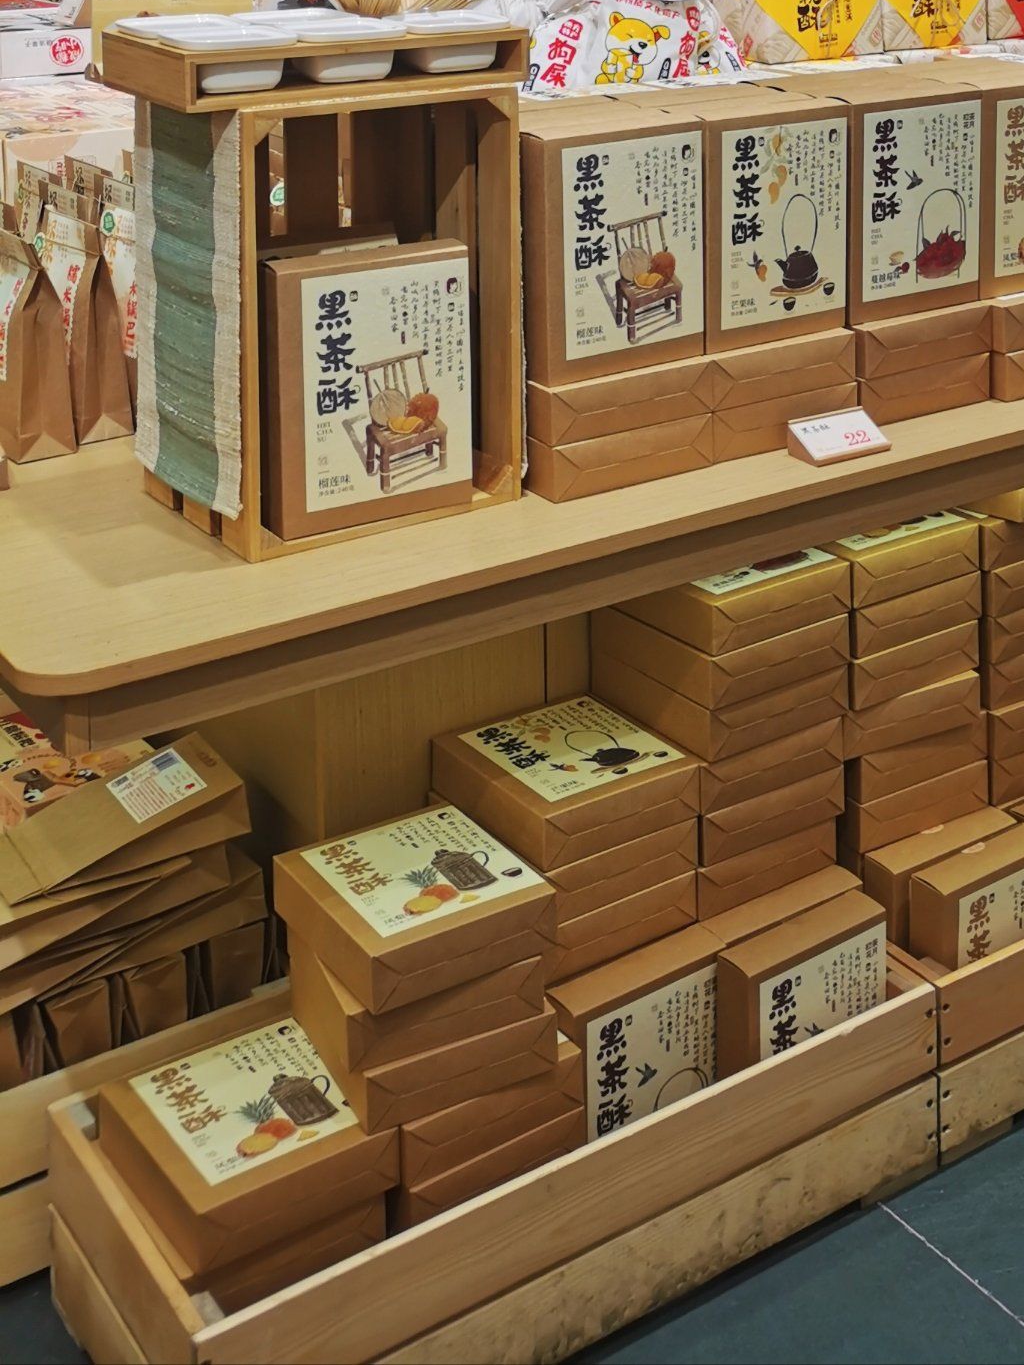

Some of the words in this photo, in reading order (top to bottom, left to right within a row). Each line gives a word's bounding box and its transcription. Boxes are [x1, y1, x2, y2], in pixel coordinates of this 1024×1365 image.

[731, 135, 763, 246] 黑茶酥
[871, 118, 901, 223] 黑茶酥
[574, 153, 609, 271] 黑茶酥
[731, 299, 756, 310] 芒果味
[315, 289, 360, 417] 黑茶酥
[844, 430, 871, 446] 22
[319, 474, 351, 489] 榴莲味
[475, 726, 551, 770] 黑茶酥
[320, 842, 394, 896] 黑茶酥
[150, 1067, 228, 1134] 黑茶酥
[597, 1017, 632, 1137] 黑茶酥
